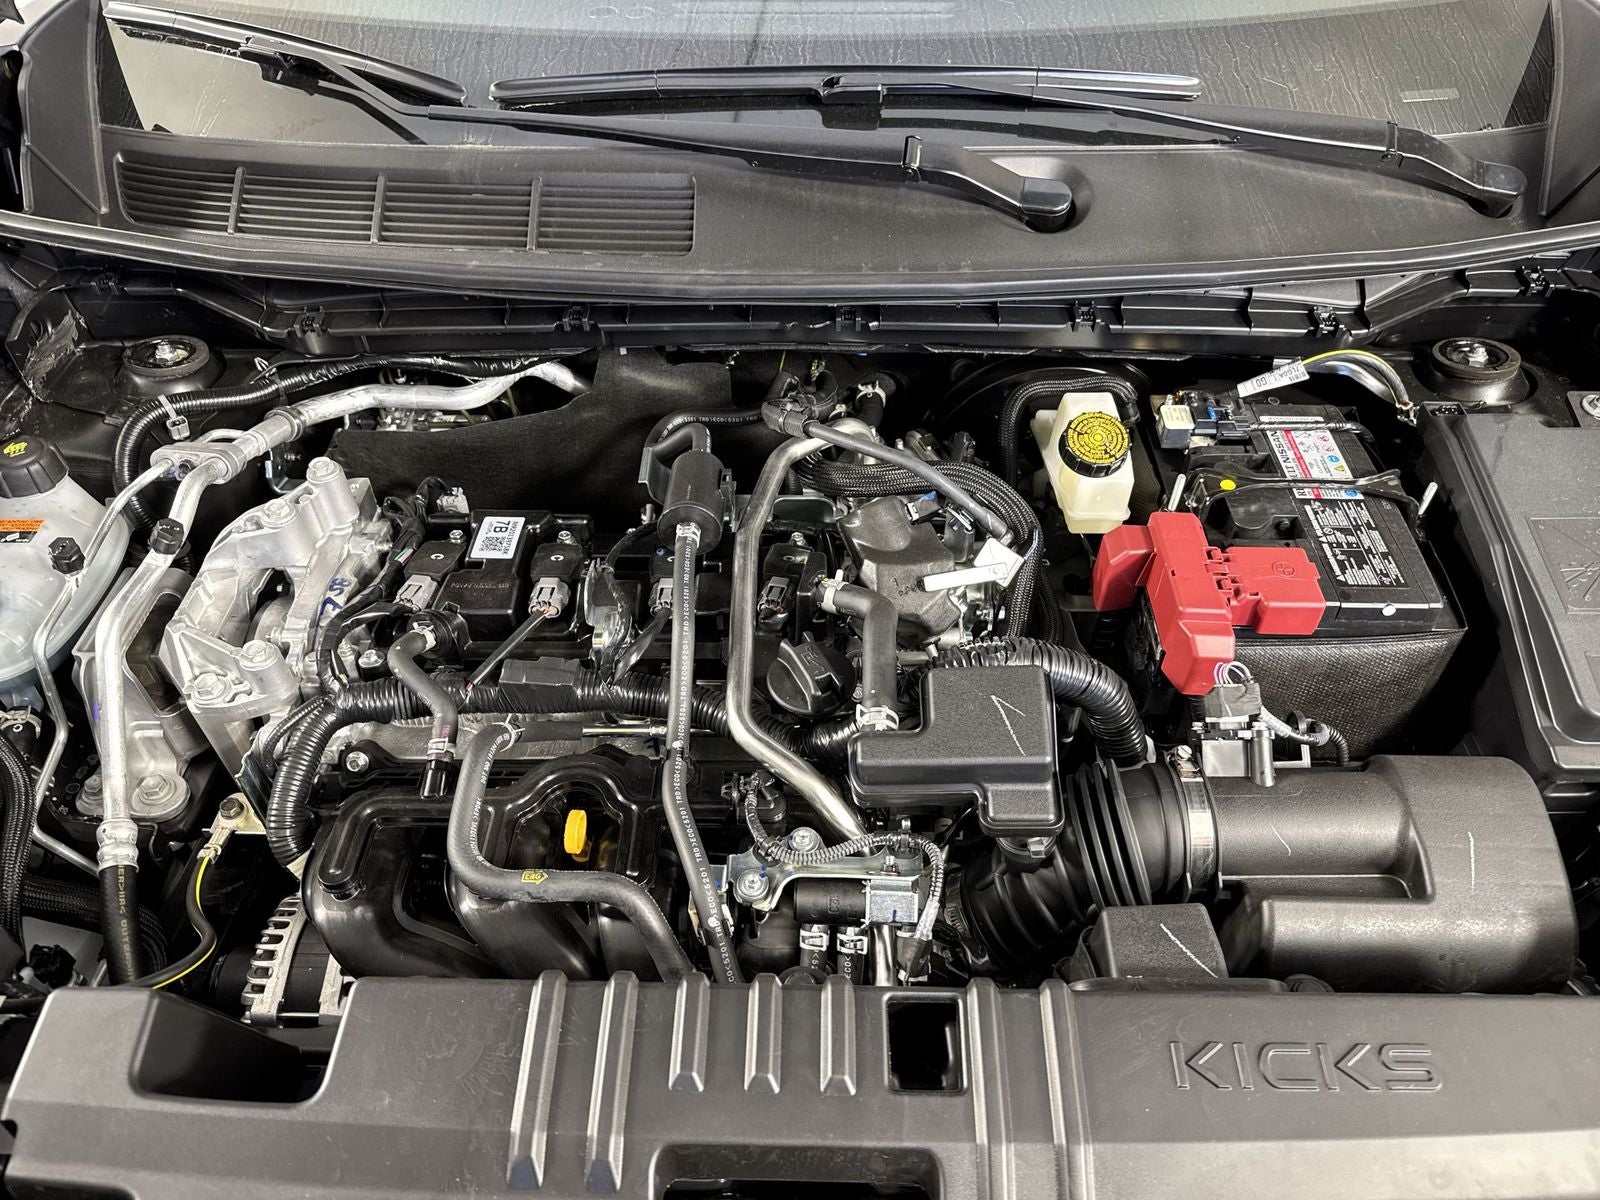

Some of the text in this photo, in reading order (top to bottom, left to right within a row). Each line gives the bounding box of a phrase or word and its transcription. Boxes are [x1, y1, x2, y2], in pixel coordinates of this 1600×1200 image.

[682, 586, 690, 635] TRD>ECO<5201
[680, 640, 689, 699] TRD>ECO<5201
[674, 754, 683, 804] TRD>ECO<5201
[680, 807, 703, 863] TRD>ECO<5201
[719, 942, 737, 985] CO<5201
[1169, 1040, 1443, 1093] KICKS
